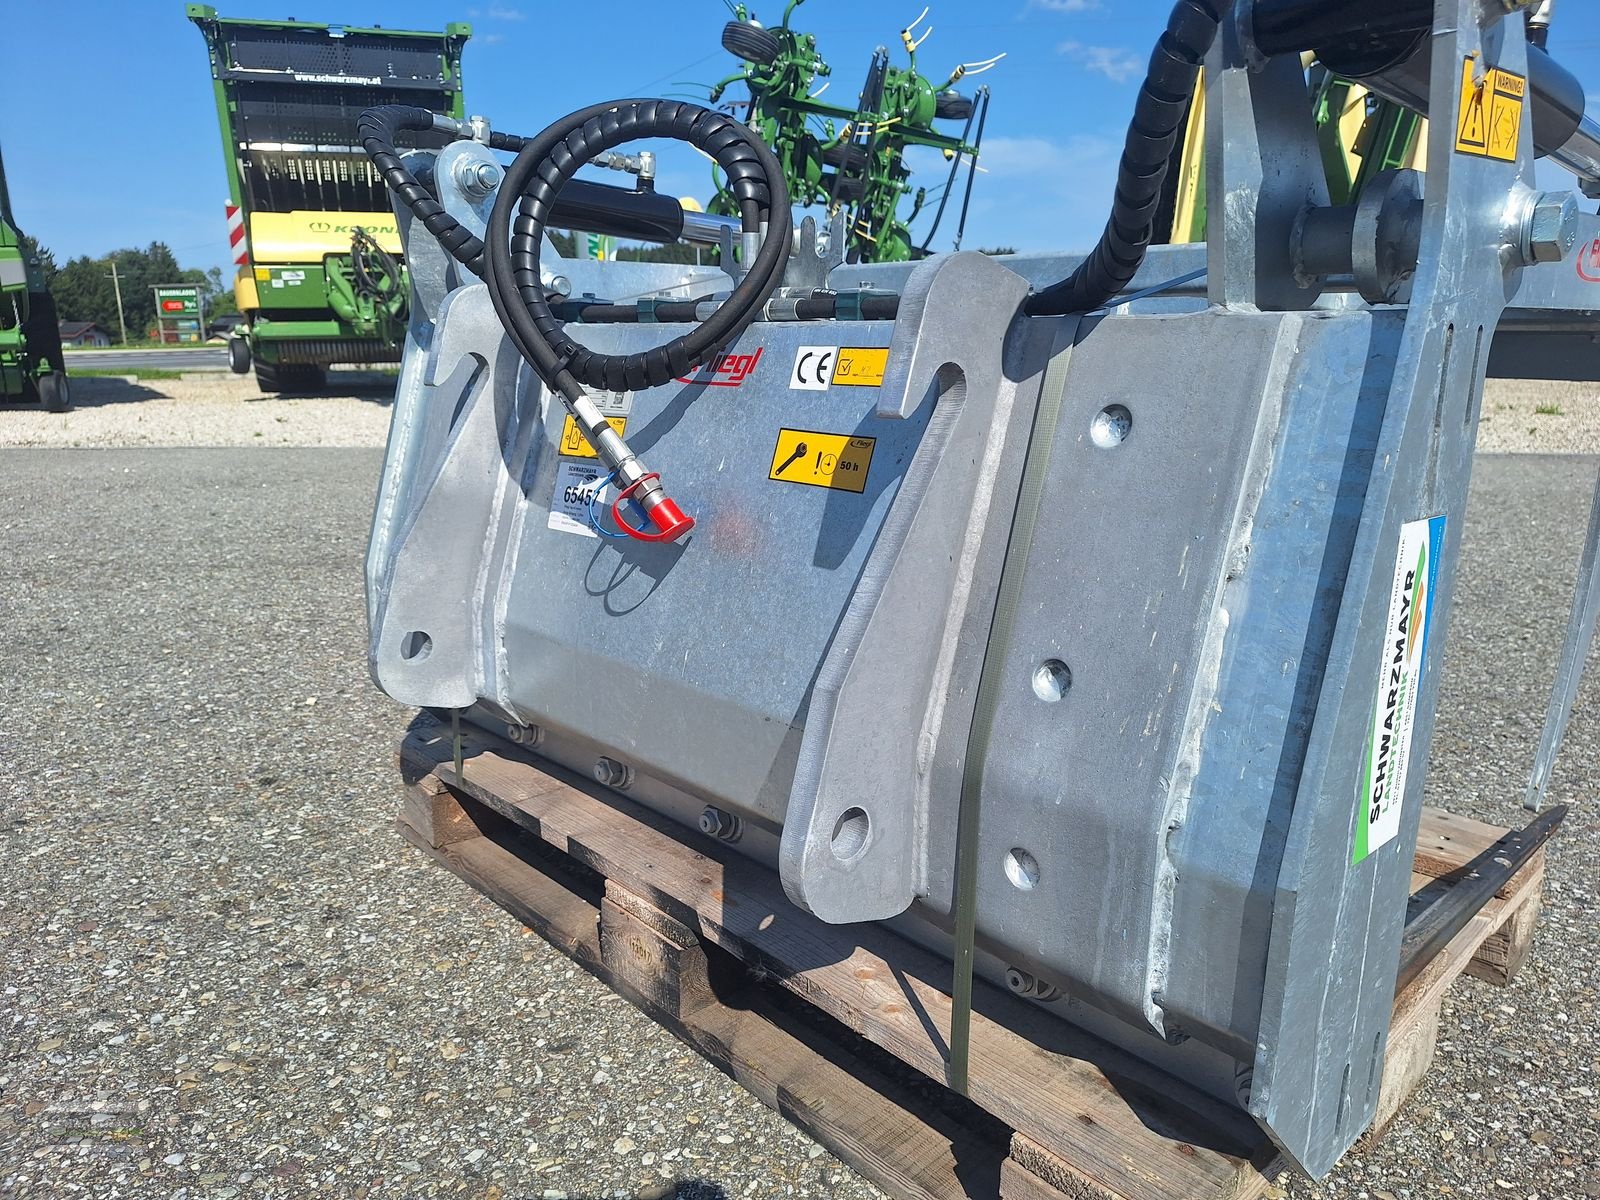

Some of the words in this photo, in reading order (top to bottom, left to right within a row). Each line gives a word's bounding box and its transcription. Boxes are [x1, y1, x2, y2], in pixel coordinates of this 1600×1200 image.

[294, 74, 381, 85] www.schwarzmayr.at
[1497, 74, 1523, 94] WARNING!
[568, 466, 597, 474] SCHWARZMAYR
[840, 461, 851, 470] 50
[853, 462, 859, 471] h
[564, 486, 600, 507] 65457
[1370, 570, 1415, 824] SCHWARZMAYR
[1382, 671, 1409, 814] LANDTECHNIK
